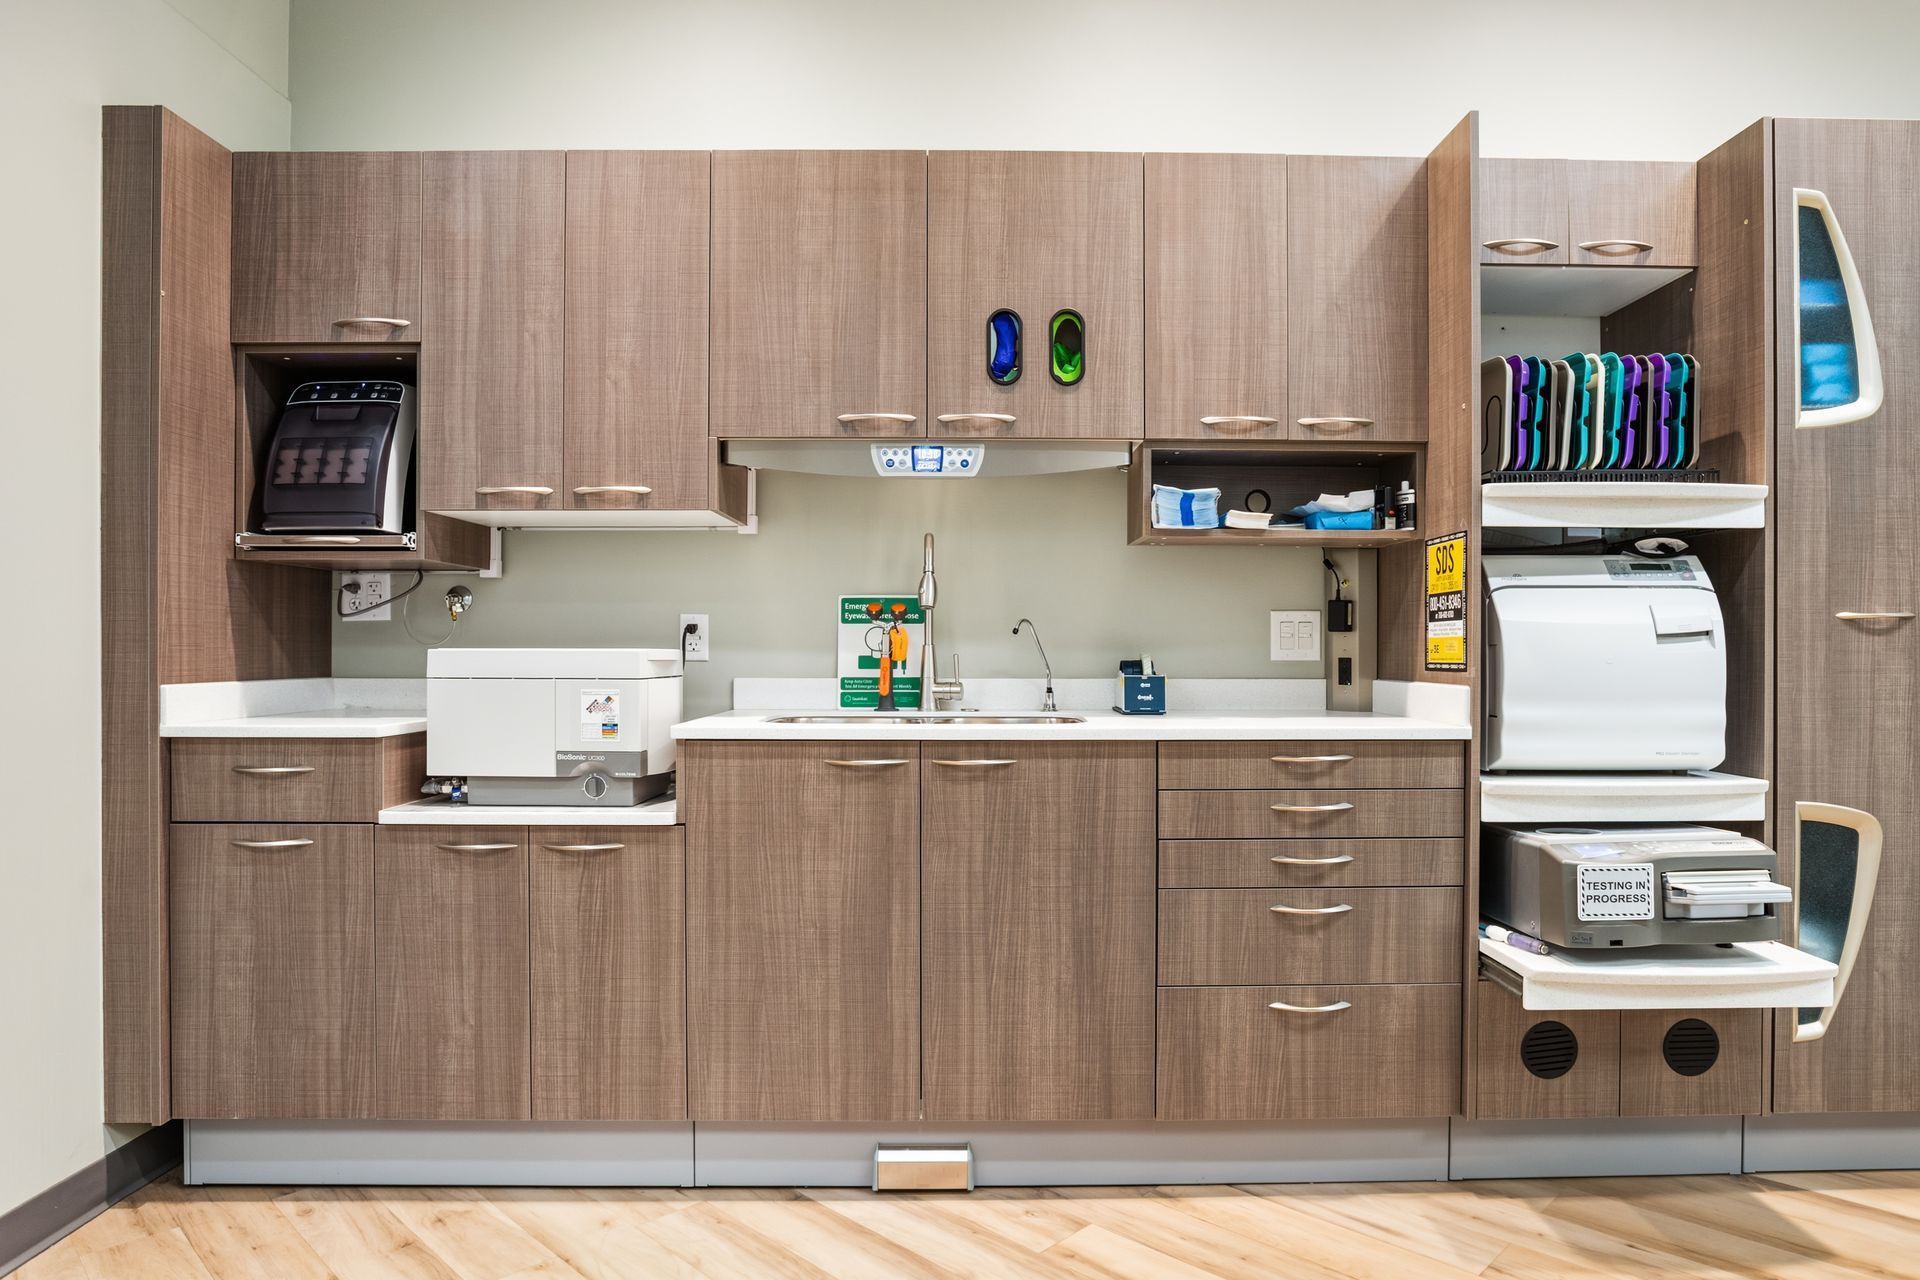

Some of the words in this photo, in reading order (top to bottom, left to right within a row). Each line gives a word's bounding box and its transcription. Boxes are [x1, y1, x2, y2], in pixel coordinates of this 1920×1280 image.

[1435, 543, 1455, 575] SDS
[556, 753, 587, 761] BioSonic
[1586, 881, 1632, 891] TESTING
[1635, 880, 1646, 890] IN
[1586, 894, 1647, 903] PROGRESS
